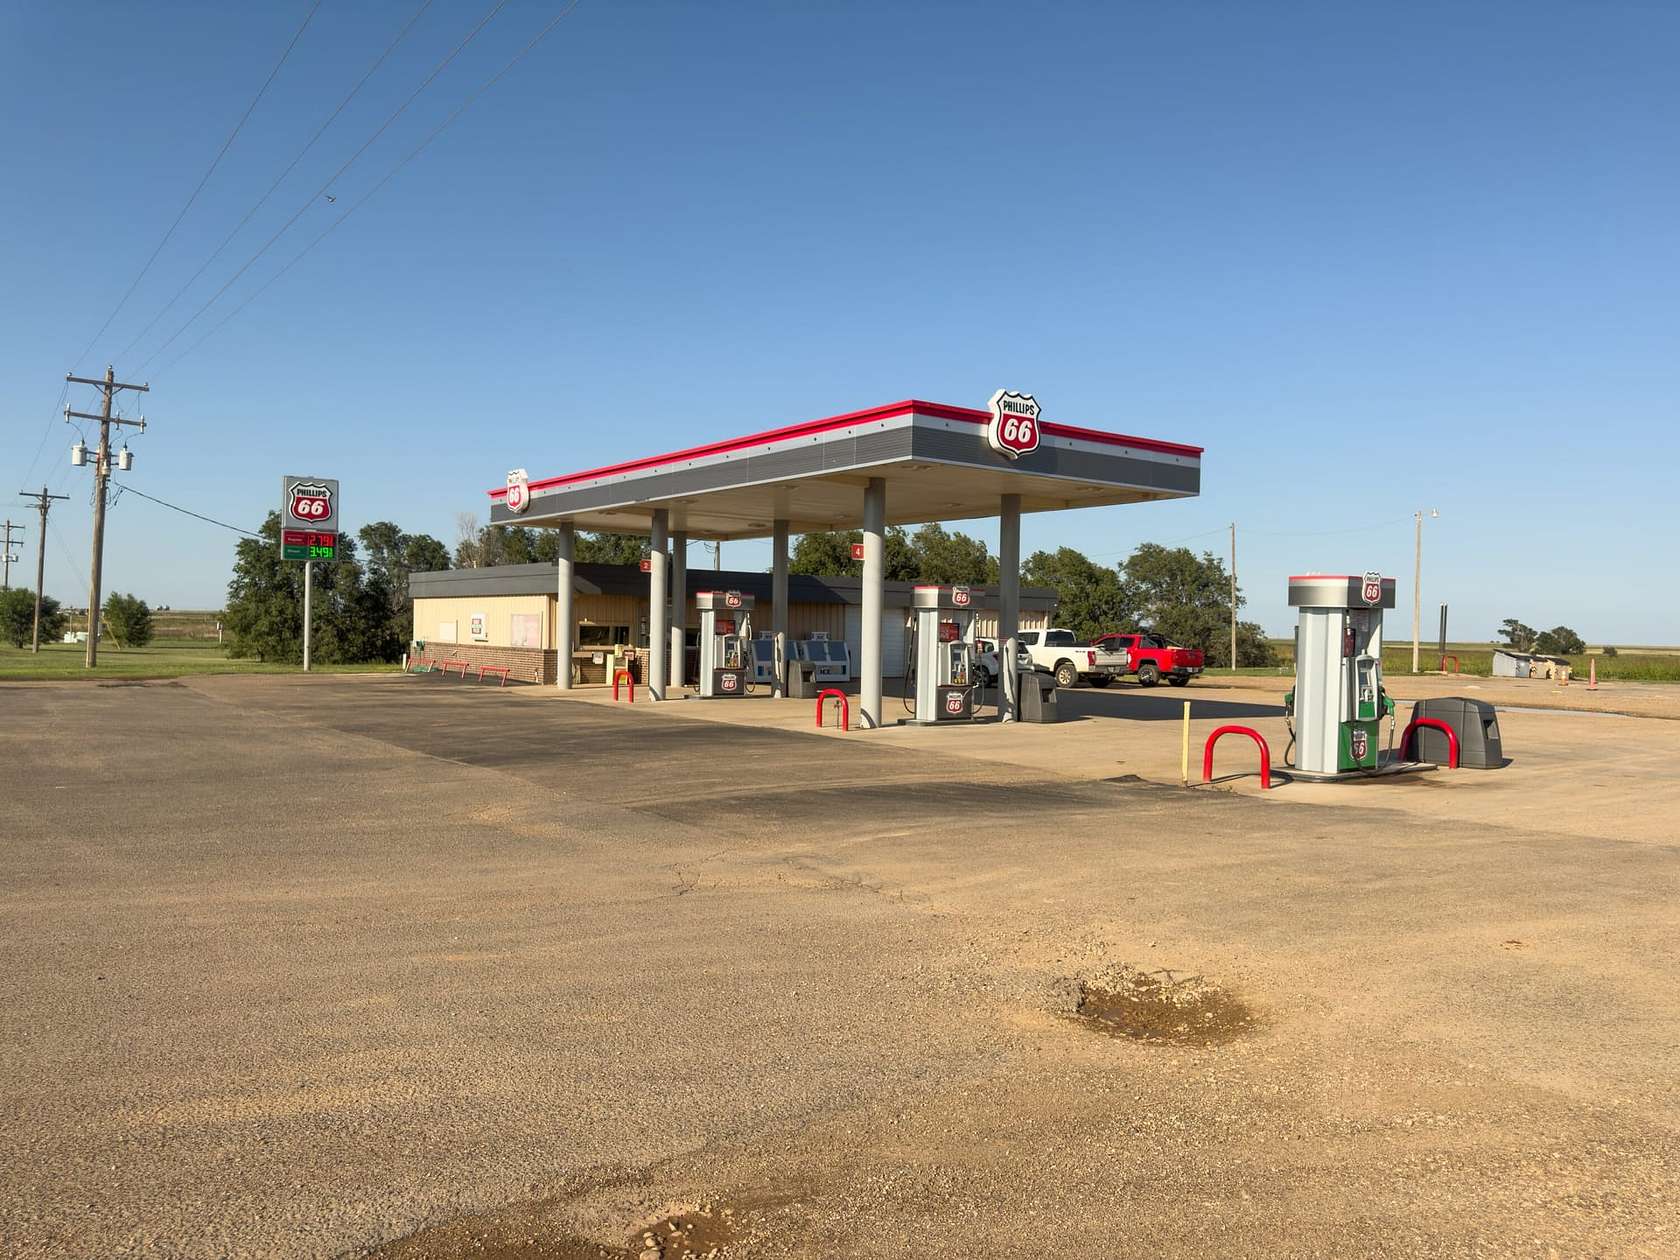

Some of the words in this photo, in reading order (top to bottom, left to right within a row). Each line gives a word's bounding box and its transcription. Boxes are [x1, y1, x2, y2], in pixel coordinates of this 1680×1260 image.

[1003, 401, 1034, 415] PHILLIPS
[1004, 418, 1032, 443] 66
[296, 488, 327, 498] PHILLIPS
[509, 487, 520, 503] 66
[298, 500, 325, 515] 66
[956, 593, 967, 602] 66
[1366, 585, 1378, 598] 66
[728, 597, 739, 605] 66
[949, 700, 961, 710] 66
